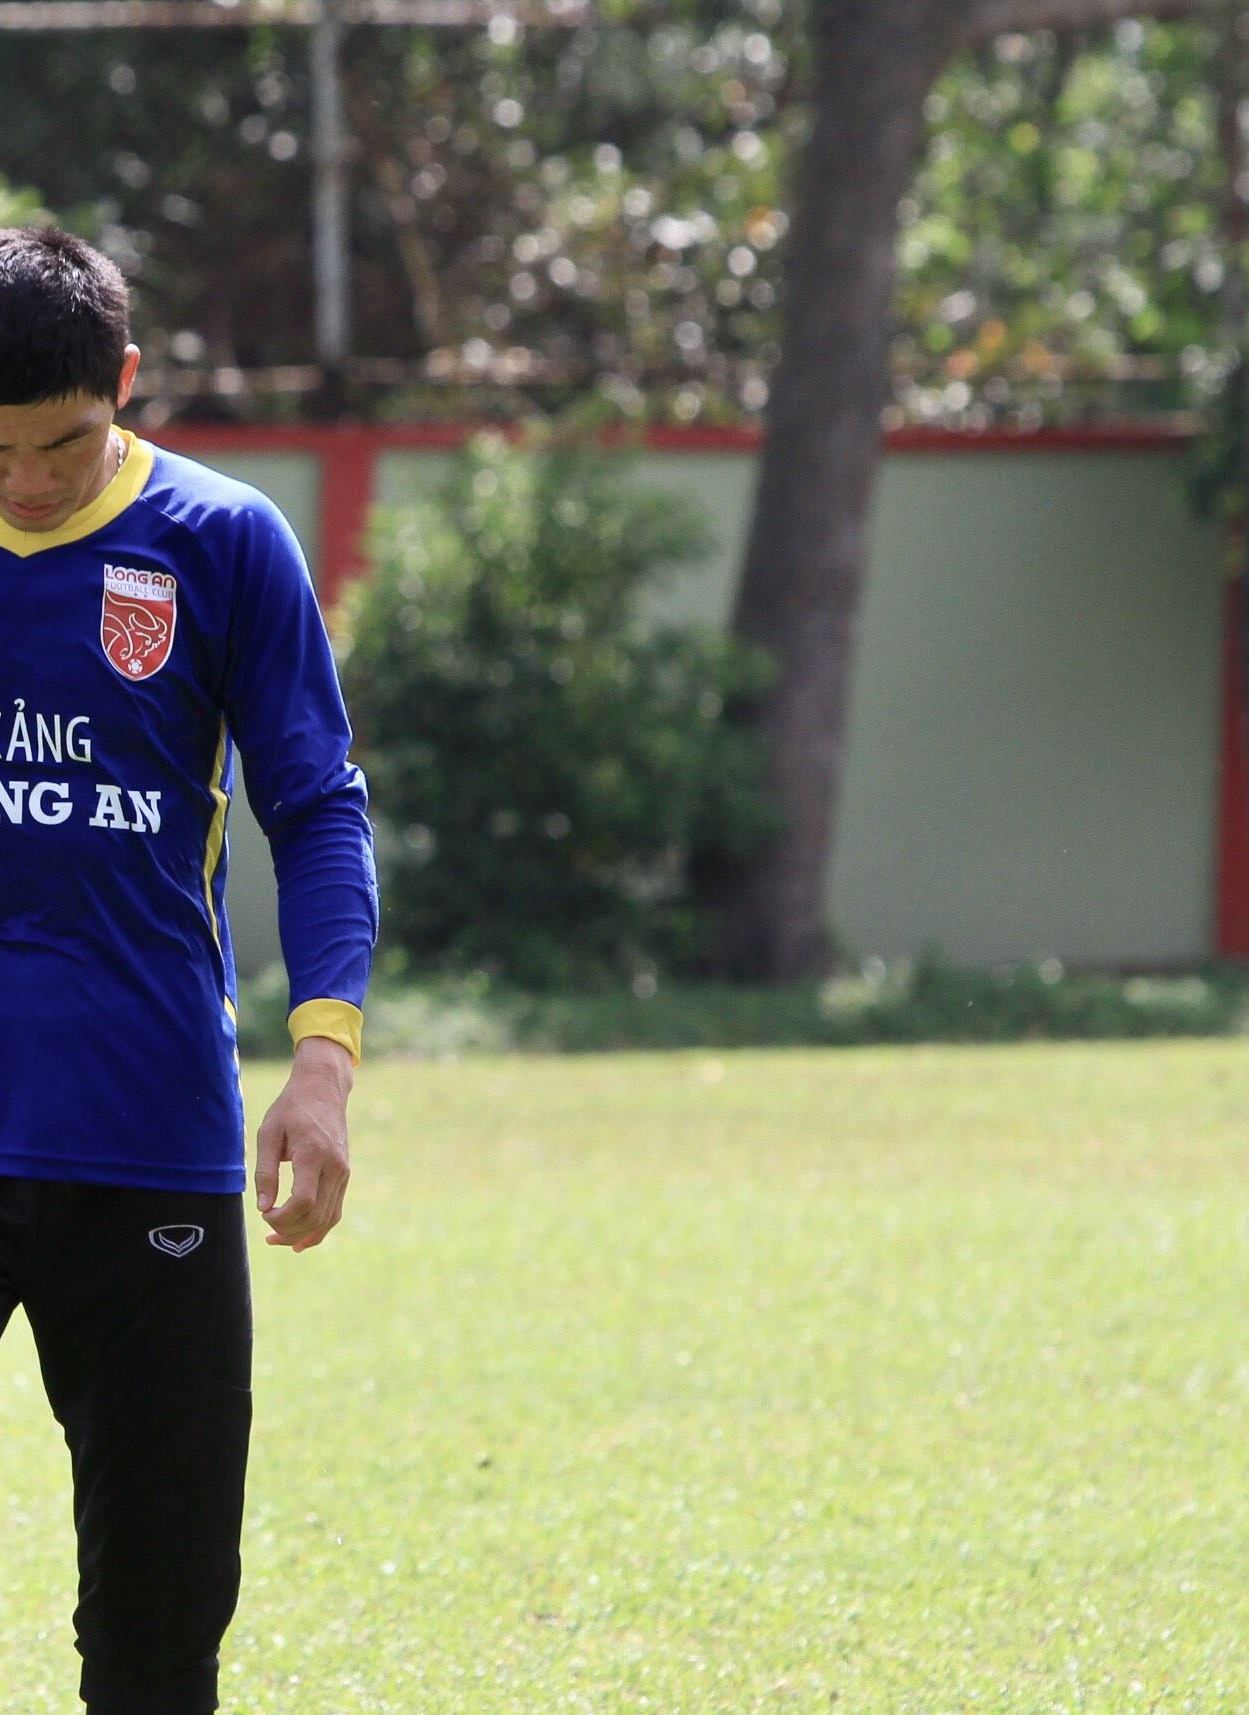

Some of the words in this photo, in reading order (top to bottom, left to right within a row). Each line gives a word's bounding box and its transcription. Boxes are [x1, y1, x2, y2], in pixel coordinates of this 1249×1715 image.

[105, 567, 148, 585] LONG
[105, 581, 149, 595] FOOTBALL
[152, 587, 174, 599] CLUB
[88, 783, 162, 834] AN
